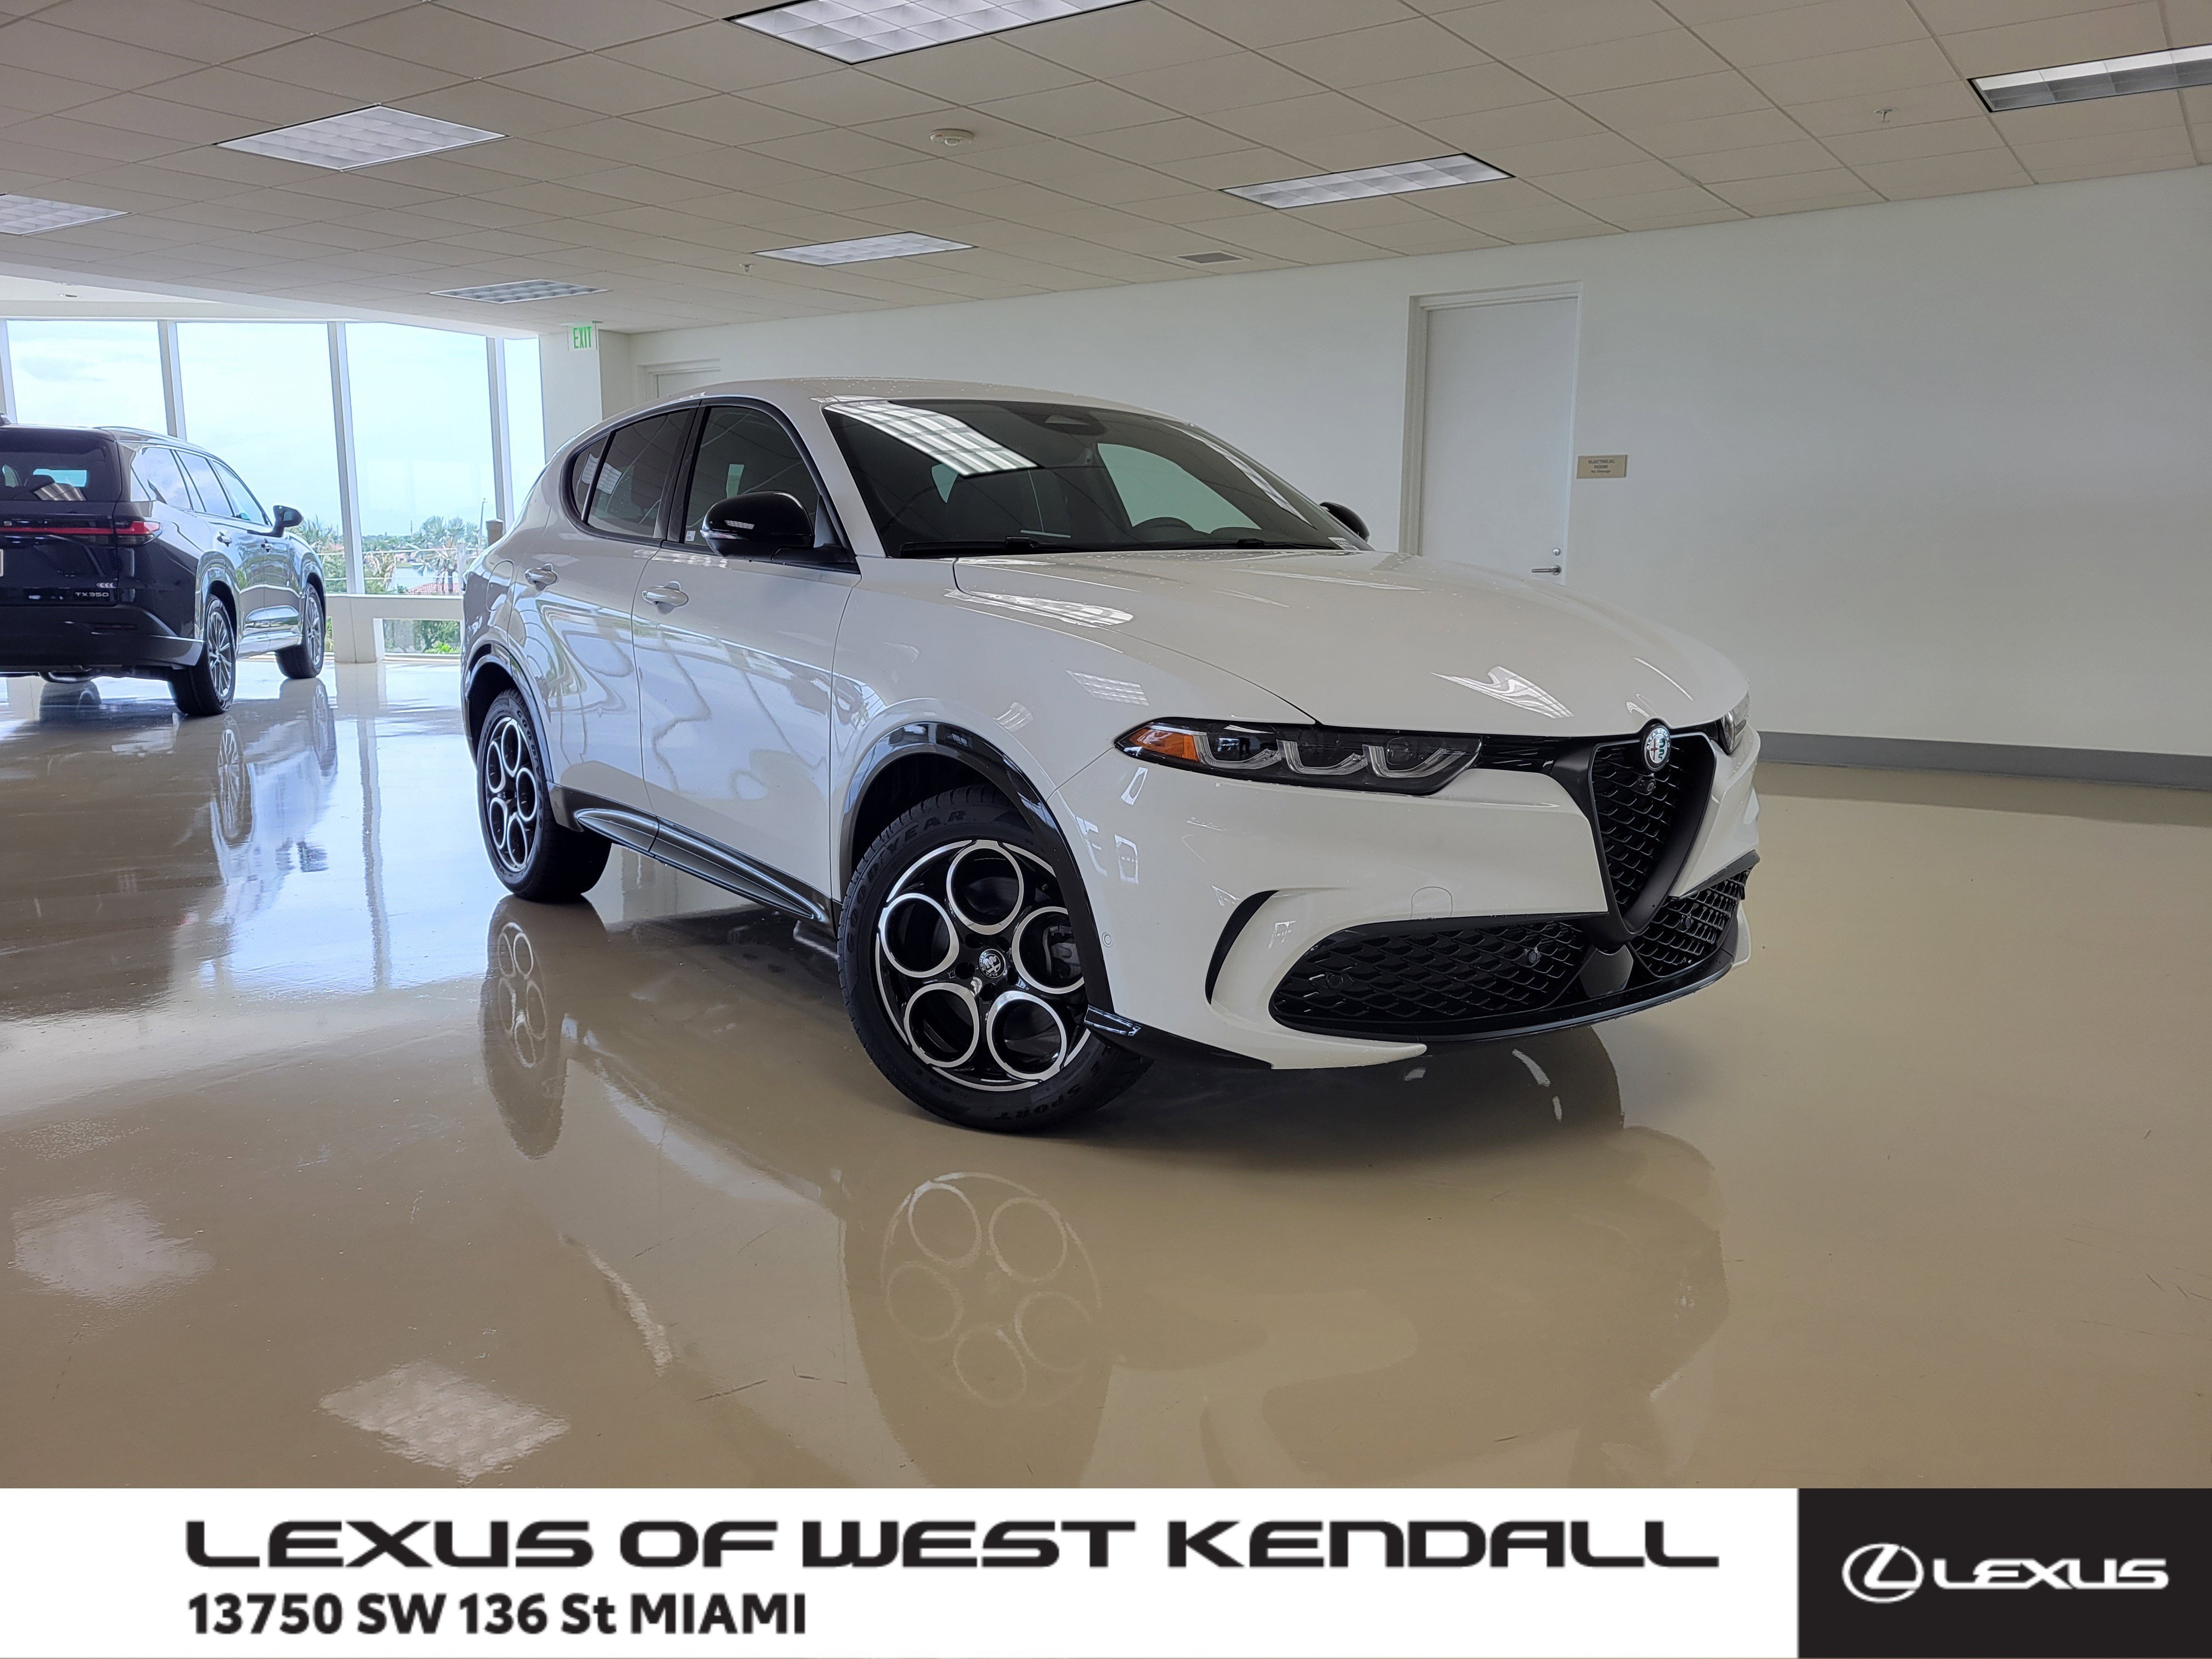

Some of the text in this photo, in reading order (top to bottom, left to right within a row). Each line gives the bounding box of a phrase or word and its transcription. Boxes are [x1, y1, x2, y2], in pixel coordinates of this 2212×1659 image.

[573, 326, 591, 349] EXIT
[1646, 732, 1656, 749] ALFA
[847, 811, 966, 953] GOODYEAR
